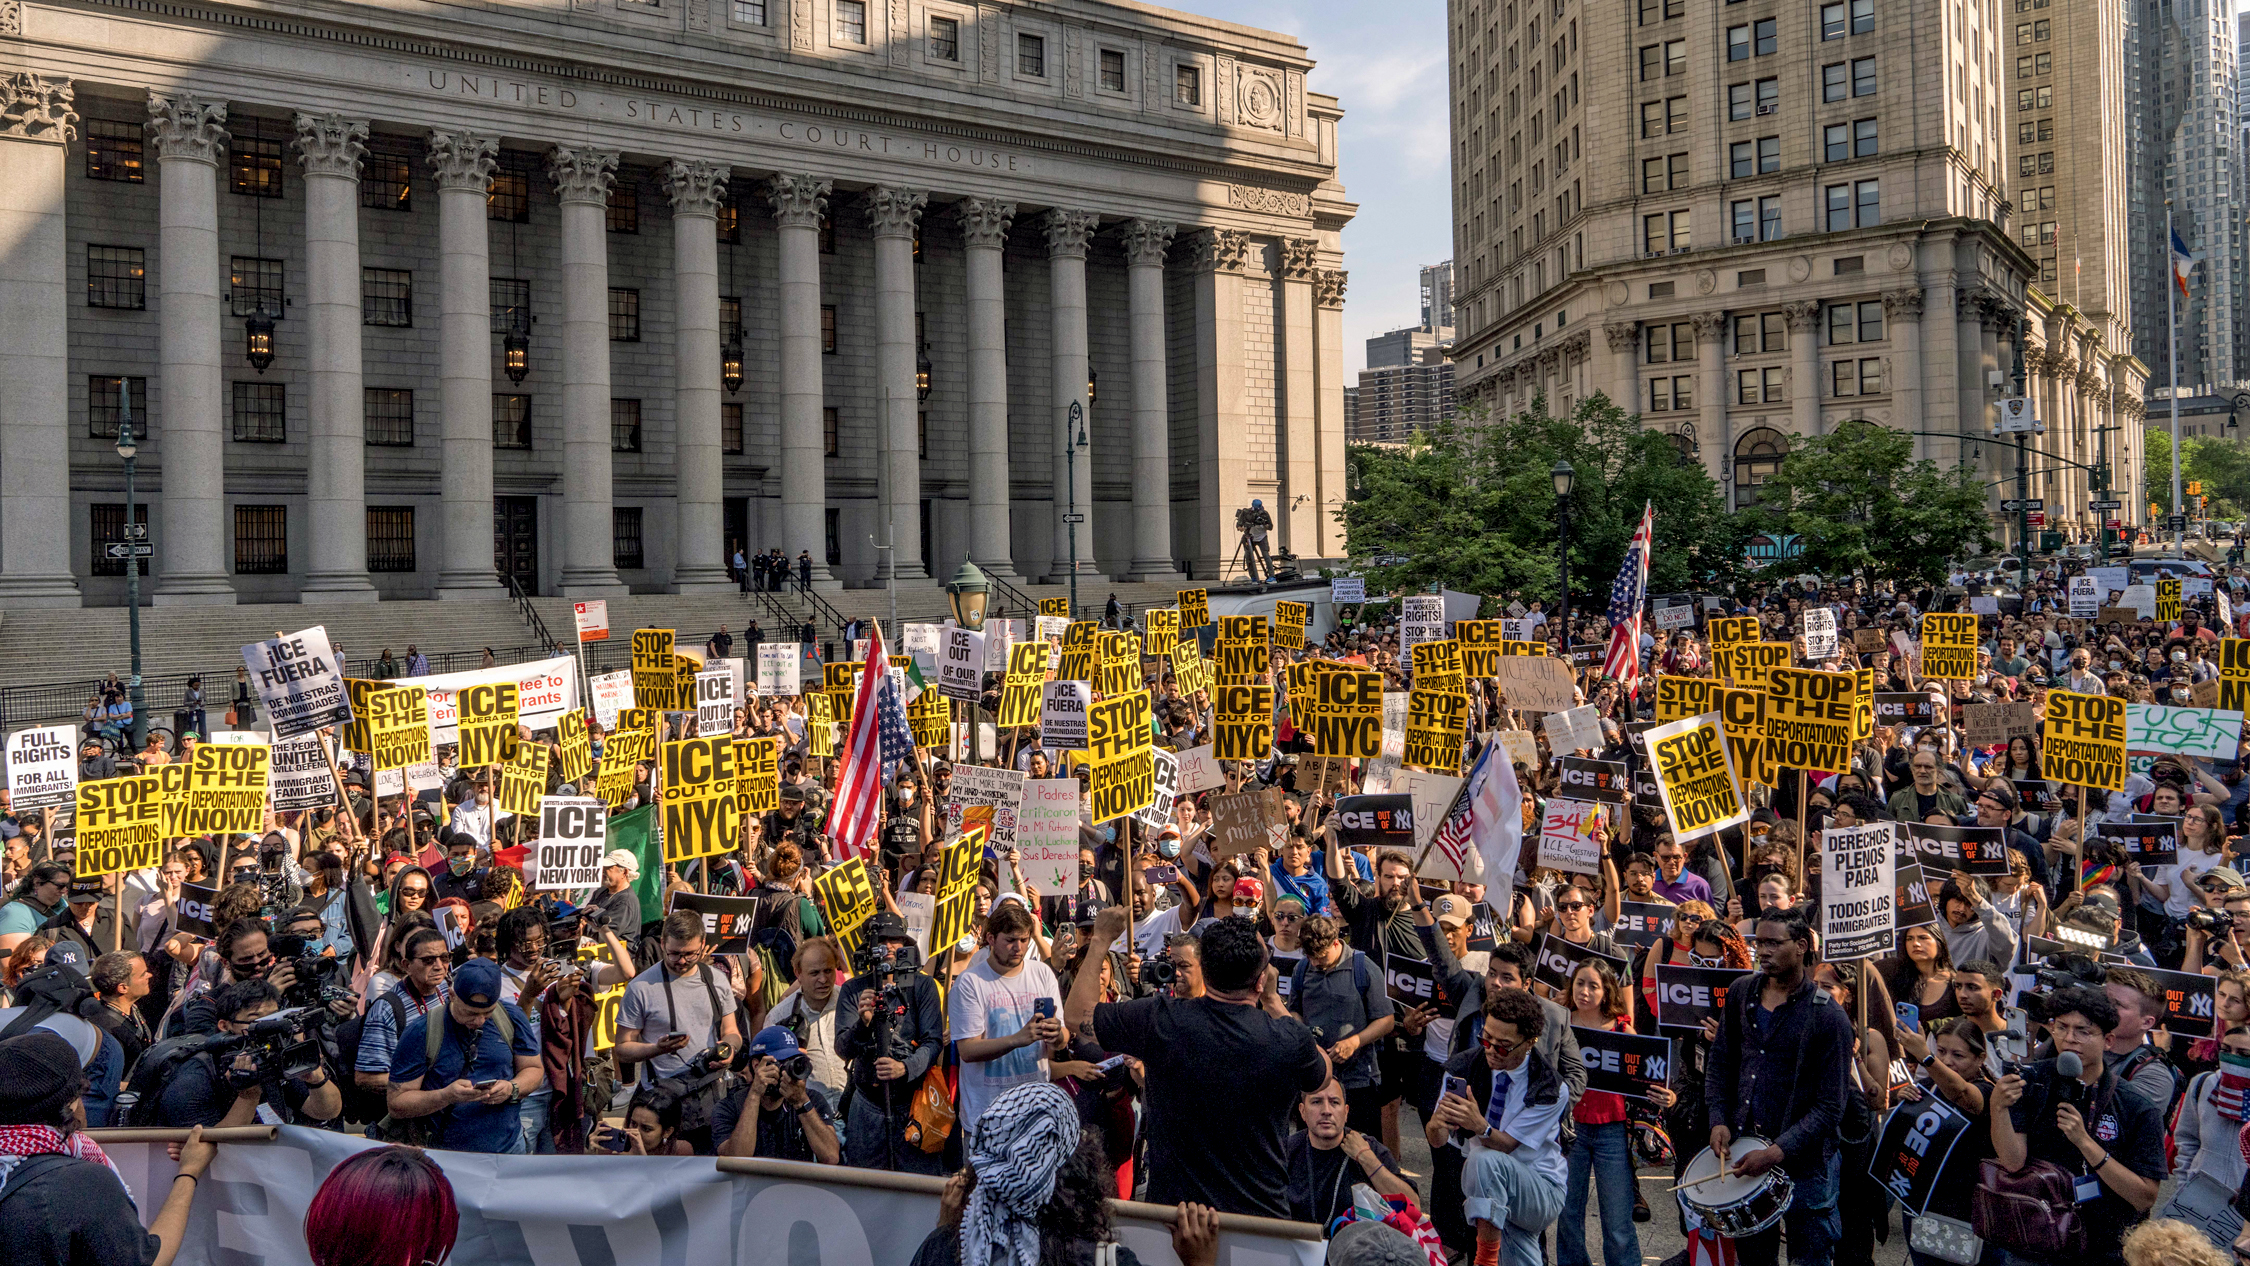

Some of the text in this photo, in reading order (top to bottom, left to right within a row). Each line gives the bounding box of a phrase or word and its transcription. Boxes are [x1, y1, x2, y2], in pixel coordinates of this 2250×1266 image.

[429, 70, 1017, 171] UNITED STATES COURT HOUSE
[2072, 588, 2095, 596] FUERA
[2077, 579, 2091, 588] ¡ICE
[2157, 581, 2181, 595] ICE
[1181, 608, 1209, 627] NYC
[1276, 614, 1303, 625] THE
[1406, 611, 1441, 621] RIGHTS!
[2156, 601, 2181, 620] NYC
[1405, 627, 1441, 636] STOP THE
[1505, 622, 1520, 631] ICE
[1807, 620, 1835, 631] RIGHTS!
[1924, 615, 1975, 633] STOP
[634, 633, 672, 652] STOP
[1149, 633, 1177, 654] NYC
[1807, 635, 1824, 646] STOP
[1924, 633, 1975, 644] THE
[267, 639, 307, 667] ¡ICE
[949, 647, 971, 662] OUT
[1009, 643, 1049, 674] ICE
[1225, 645, 1268, 674] NYC
[1735, 645, 1788, 667] STOP
[260, 657, 328, 687] FUERA
[548, 676, 563, 686] to
[943, 665, 975, 680] OF OUR
[941, 676, 978, 688] COMMUNITIES!
[1054, 684, 1076, 697] ¡ICE
[1320, 673, 1380, 704] ICE
[1769, 669, 1853, 702] STOP
[269, 683, 339, 709] DE NUESTRAS
[1505, 687, 1565, 709] New York
[272, 694, 344, 719] COMUNIDADES!
[719, 704, 732, 718] OF
[1047, 699, 1084, 712] FUERA
[1318, 705, 1380, 713] OUT OF
[1768, 695, 1850, 721] THE
[1876, 703, 1905, 715] ICE
[2049, 693, 2123, 724] STOP
[460, 715, 498, 725] FUERA
[700, 720, 732, 732] NEW YORK
[1251, 714, 1270, 722] OF
[374, 727, 428, 749] DEPORTATIONS
[1318, 716, 1379, 756] NYC
[1407, 729, 1461, 748] DEPORTATIONS
[1767, 717, 1849, 746] DEPORTATIONS
[2007, 726, 2028, 734] FREE
[2048, 717, 2124, 742] THE
[22, 732, 60, 748] FULL
[272, 744, 289, 752] THE
[460, 723, 517, 766] NYC
[810, 725, 831, 754] NYC
[1091, 724, 1150, 759] THE
[1215, 724, 1269, 758] NYC
[1657, 726, 1715, 767] STOP
[13, 745, 70, 764] RIGHTS
[197, 747, 267, 770] STOP
[376, 744, 430, 769] NOW!
[1404, 745, 1461, 768] NOW!
[1765, 737, 1847, 771] NOW!
[2046, 737, 2122, 765] DEPORTATIONS
[273, 761, 328, 773] WILL DEFEND
[666, 738, 734, 787] ICE
[1092, 749, 1152, 791] DEPORTATIONS
[1663, 750, 1725, 784] THE
[17, 770, 68, 785] FOR ALL
[194, 771, 265, 785] THE
[275, 774, 331, 788] IMMIGRANT
[378, 774, 391, 785] LOVE
[955, 765, 1004, 779] YOUR GROCERY
[2045, 756, 2122, 789] NOW!
[14, 782, 72, 796] IMMIGRANTS!
[276, 783, 331, 798] FAMILIES!
[665, 780, 734, 799] OUT OF
[953, 776, 995, 789] ISN'T MORE
[953, 786, 963, 794] MY
[1669, 771, 1730, 806] DEPORTATIONS
[192, 791, 262, 808] DEPORTATIONS
[1038, 785, 1074, 800] Padres
[1094, 773, 1152, 821] NOW!
[1001, 799, 1019, 808] MOM!
[1550, 801, 1566, 809] OUR
[1674, 790, 1738, 830] NOW!
[189, 809, 261, 831] NOW!
[543, 807, 603, 838] ICE
[1152, 809, 1167, 825] YORK
[1543, 813, 1580, 837] 34
[667, 795, 737, 859] NYC
[995, 828, 1015, 841] FUK
[1034, 822, 1044, 832] Mi
[80, 823, 159, 850] DEPORTATIONS
[1034, 836, 1043, 846] Yo
[1829, 828, 1890, 852] DERECHOS
[1022, 848, 1078, 860] Sus Derechos
[1962, 842, 1977, 850] OUT
[80, 842, 159, 874] NOW!
[541, 846, 578, 868] OUT
[1544, 852, 1575, 866] HISTORY
[1835, 847, 1885, 871] PLENOS
[539, 868, 600, 884] NEW YORK
[1845, 871, 1879, 888] PARA
[820, 859, 869, 918] ICE
[898, 895, 924, 909] Morons
[1829, 895, 1890, 919] TODOS LOS
[721, 914, 734, 924] OUT
[1829, 914, 1890, 934] INMIGRANTES!
[721, 924, 730, 934] OF
[1387, 968, 1433, 998] ICE
[1660, 982, 1711, 1007] ICE
[2166, 990, 2185, 1002] OUT
[2169, 1001, 2182, 1012] OF
[1624, 1053, 1641, 1065] OUT
[1627, 1064, 1637, 1076] OF
